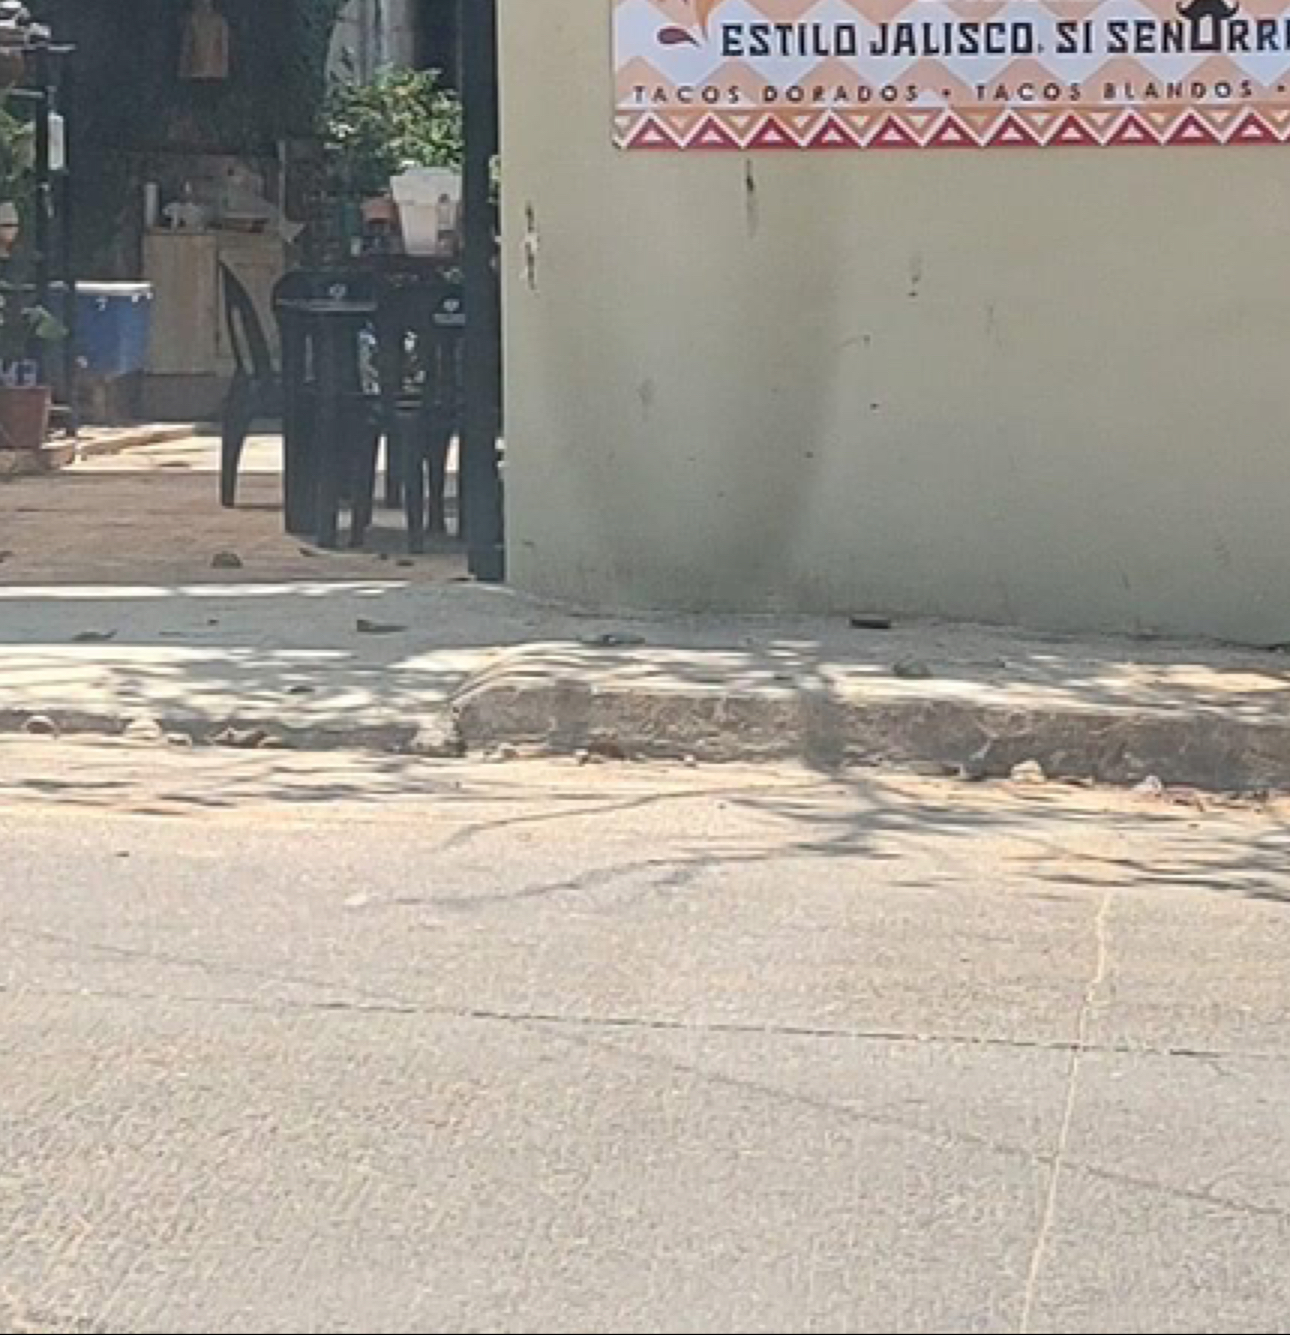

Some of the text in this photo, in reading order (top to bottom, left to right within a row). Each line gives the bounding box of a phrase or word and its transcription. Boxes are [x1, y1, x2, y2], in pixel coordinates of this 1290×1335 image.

[722, 22, 856, 56] ESTILO
[1056, 19, 1093, 53] SI
[633, 85, 740, 104] TACOS
[764, 84, 918, 103] DORADOS
[975, 82, 1081, 101] TACOS
[1103, 80, 1252, 99] BLANDOS
